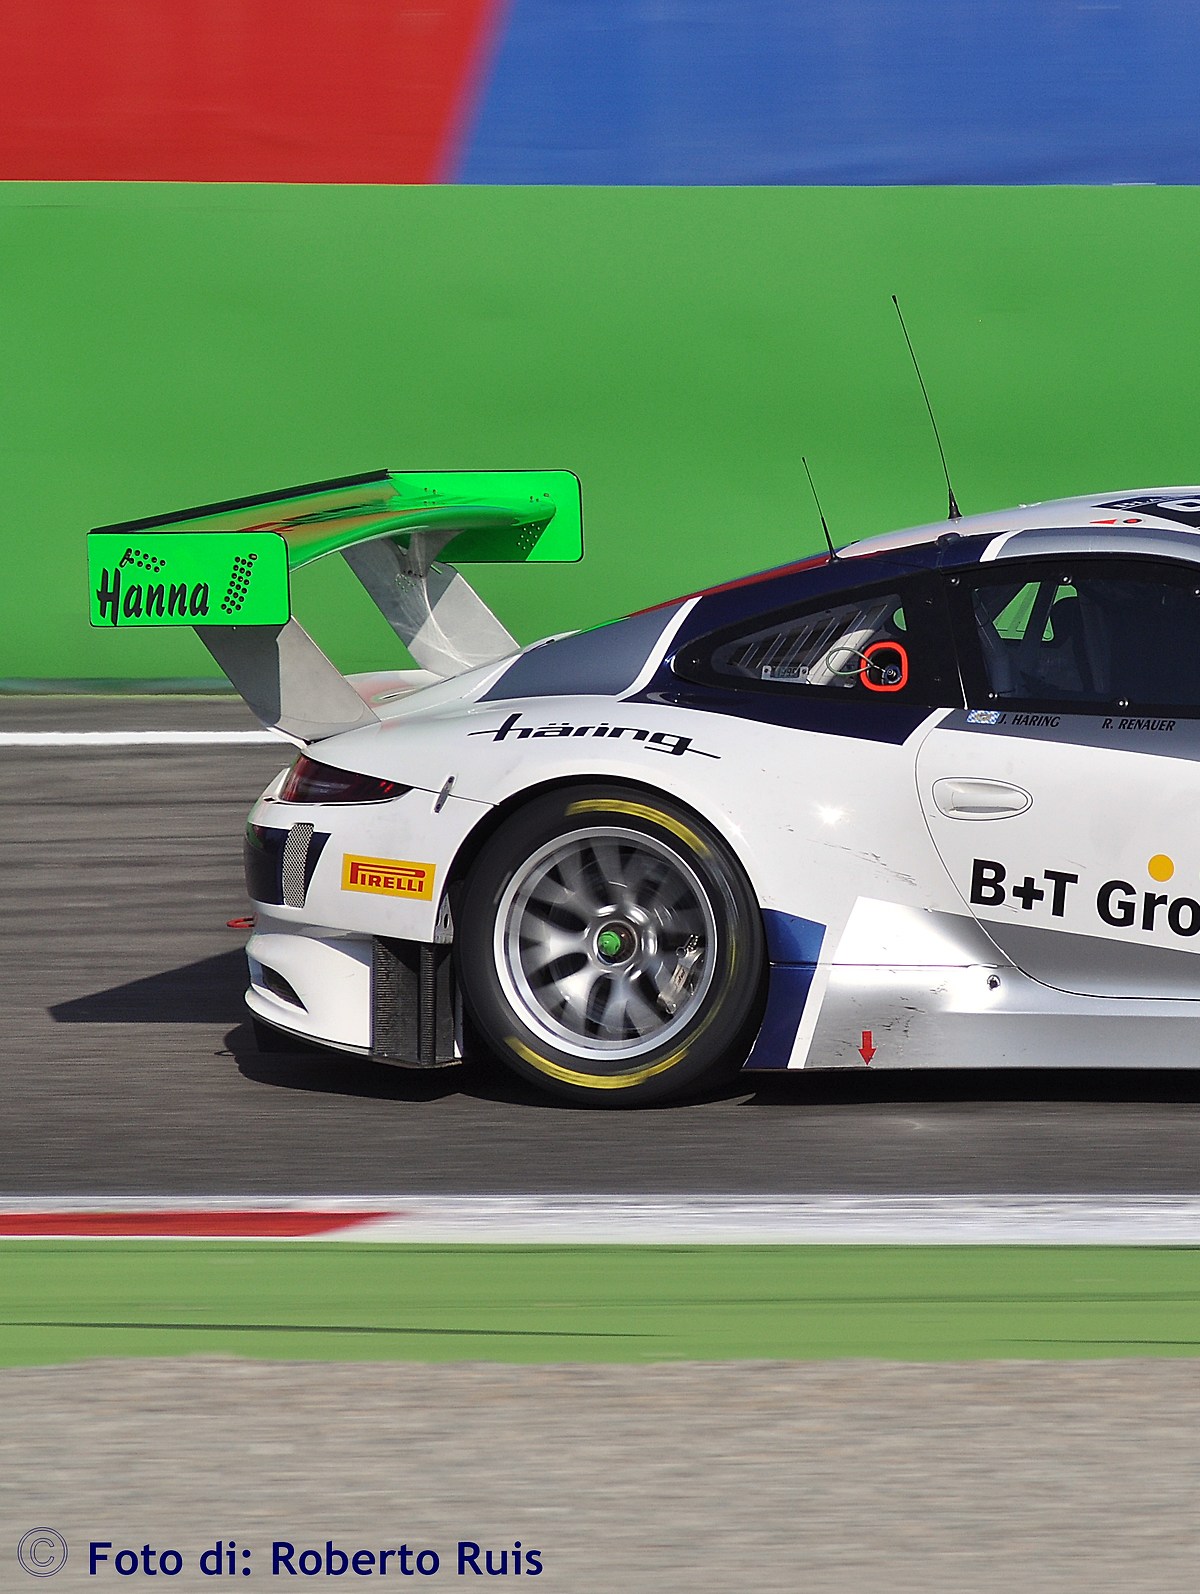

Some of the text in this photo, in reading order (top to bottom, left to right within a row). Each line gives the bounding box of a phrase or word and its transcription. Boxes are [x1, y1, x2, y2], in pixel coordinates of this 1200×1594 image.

[96, 567, 209, 626] Hanna
[467, 713, 722, 759] häring
[998, 713, 1007, 725] J.
[1102, 718, 1177, 732] R. RENAUER
[350, 862, 426, 893] PIRELLI
[969, 858, 1079, 917] B+T
